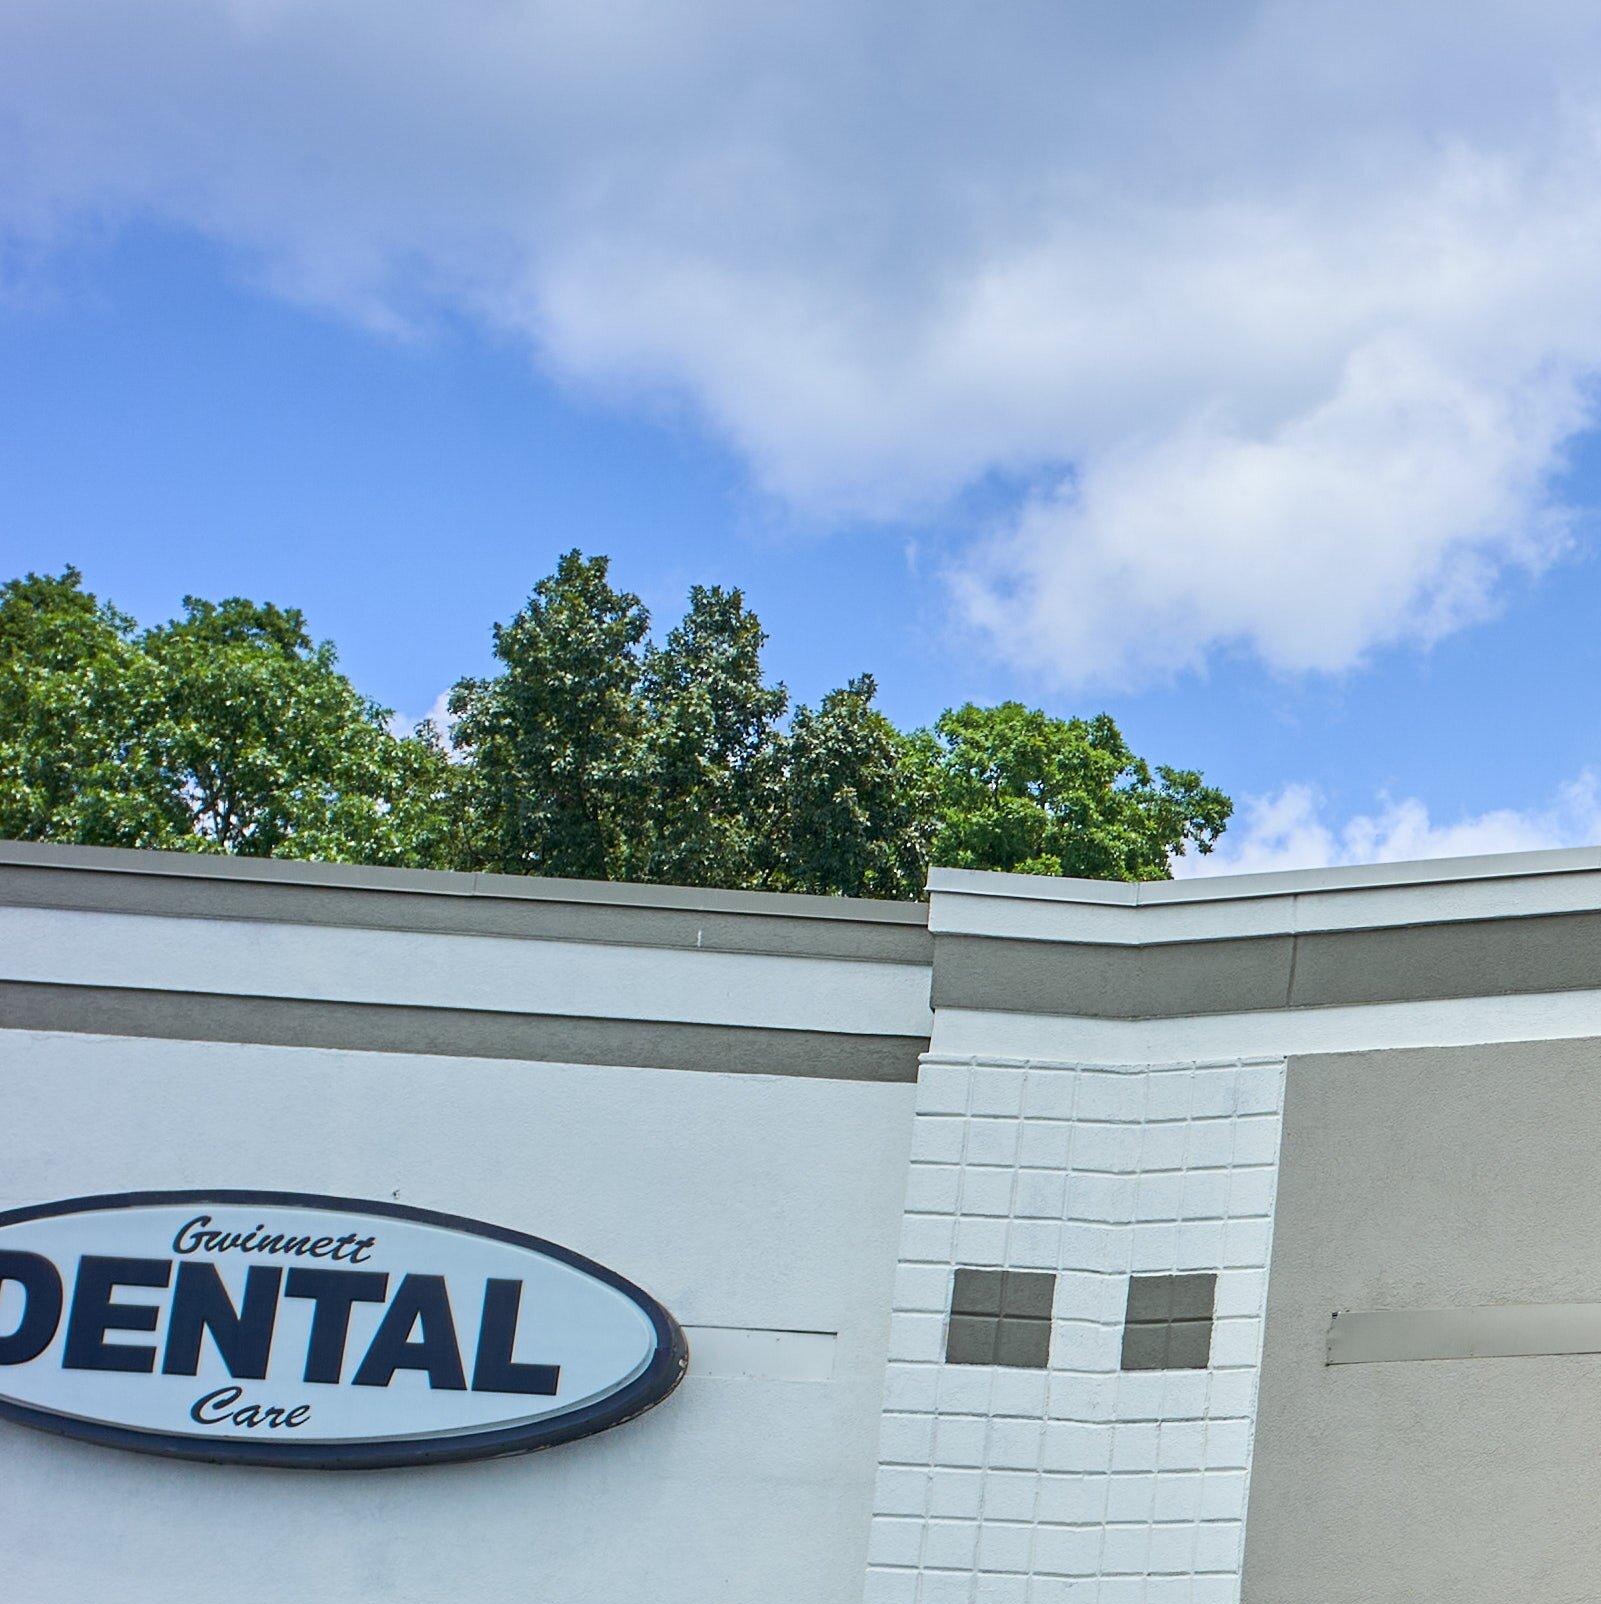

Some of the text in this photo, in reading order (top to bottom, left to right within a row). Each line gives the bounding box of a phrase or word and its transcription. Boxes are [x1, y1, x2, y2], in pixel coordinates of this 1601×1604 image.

[172, 1214, 380, 1264] Gwinnett
[0, 1249, 561, 1396] DENTAL
[189, 1385, 311, 1429] Care
